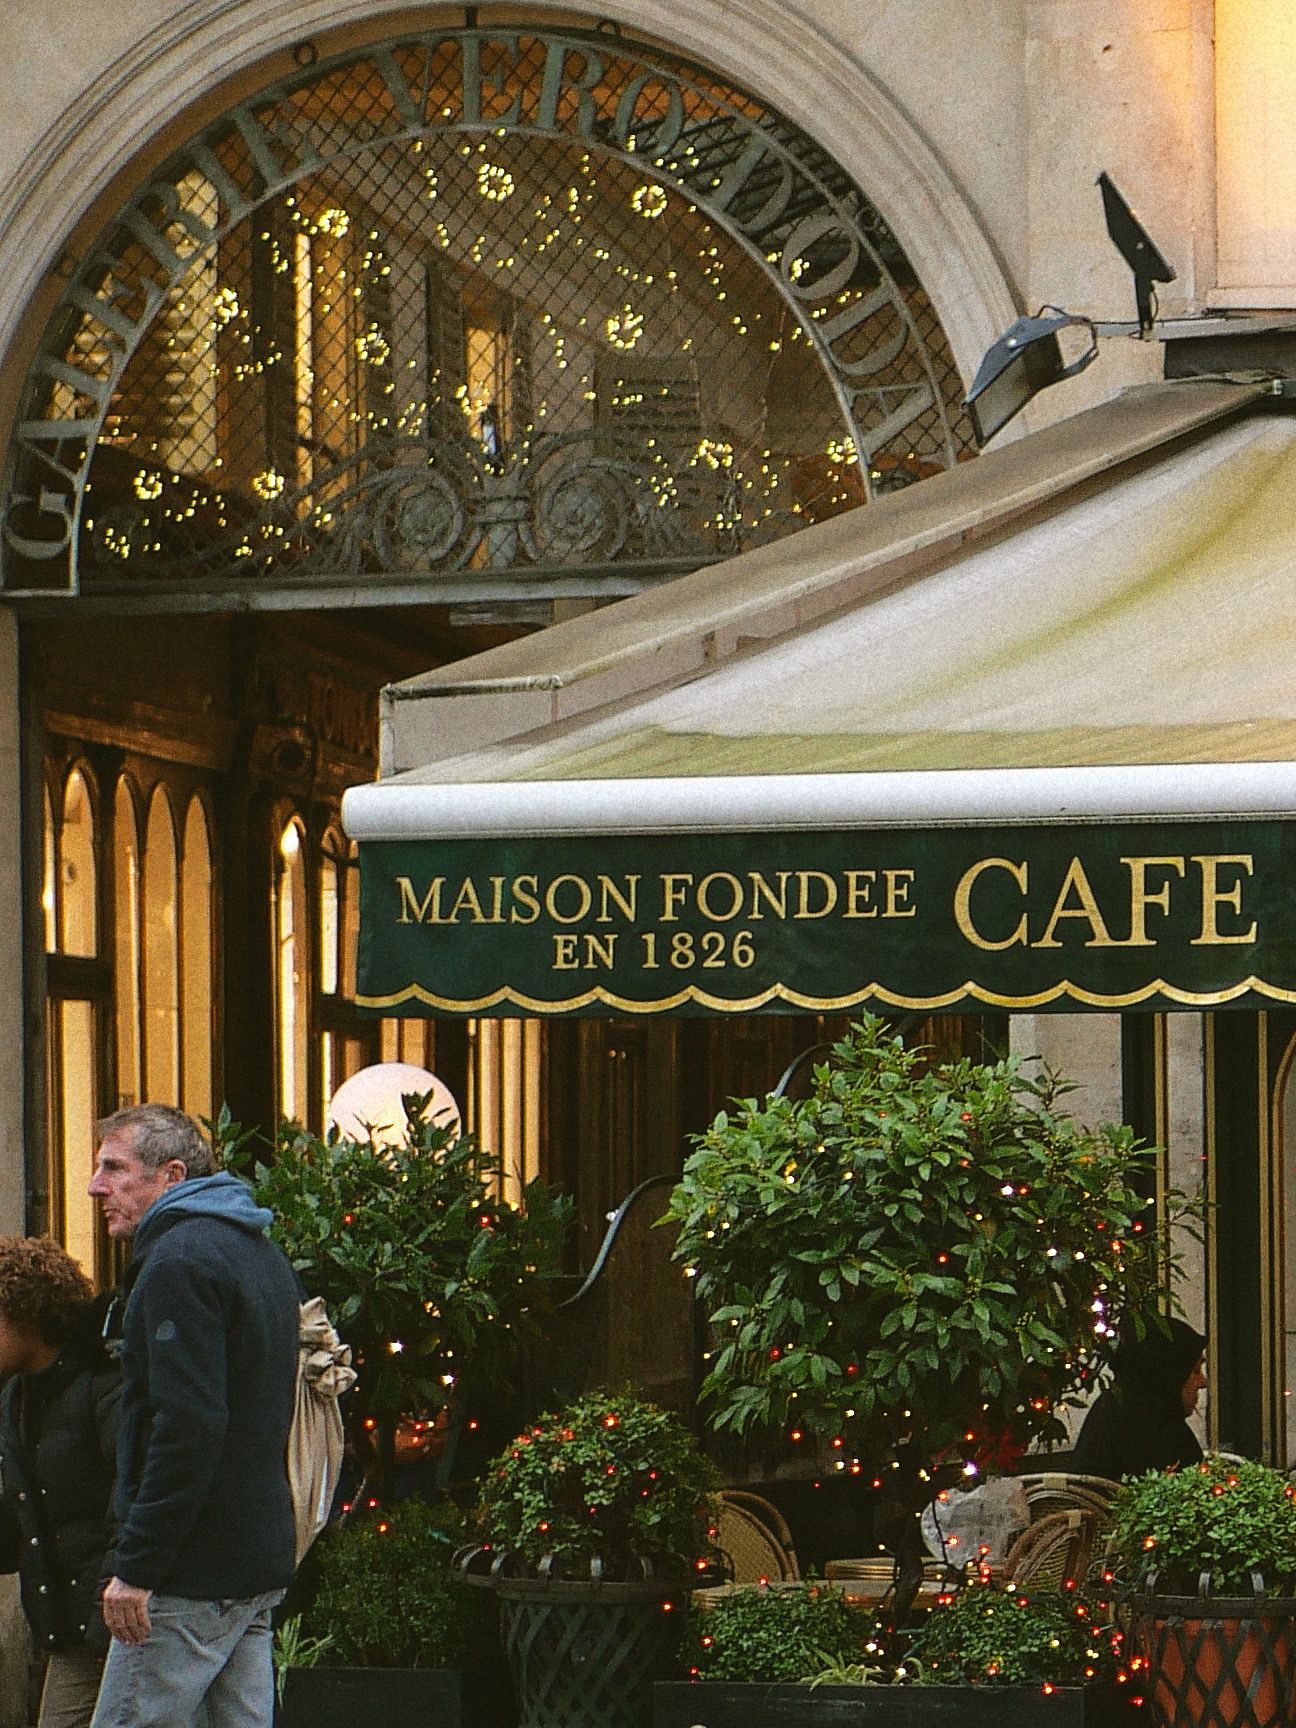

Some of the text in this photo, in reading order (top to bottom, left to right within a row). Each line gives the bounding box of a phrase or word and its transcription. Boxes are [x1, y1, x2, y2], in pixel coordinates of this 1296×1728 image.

[2, 94, 325, 562] GALERIE
[365, 34, 688, 158] VERO
[395, 869, 917, 926] MAISON FONDEE
[953, 852, 1259, 953] CAFE
[552, 930, 757, 970] EN 1826
